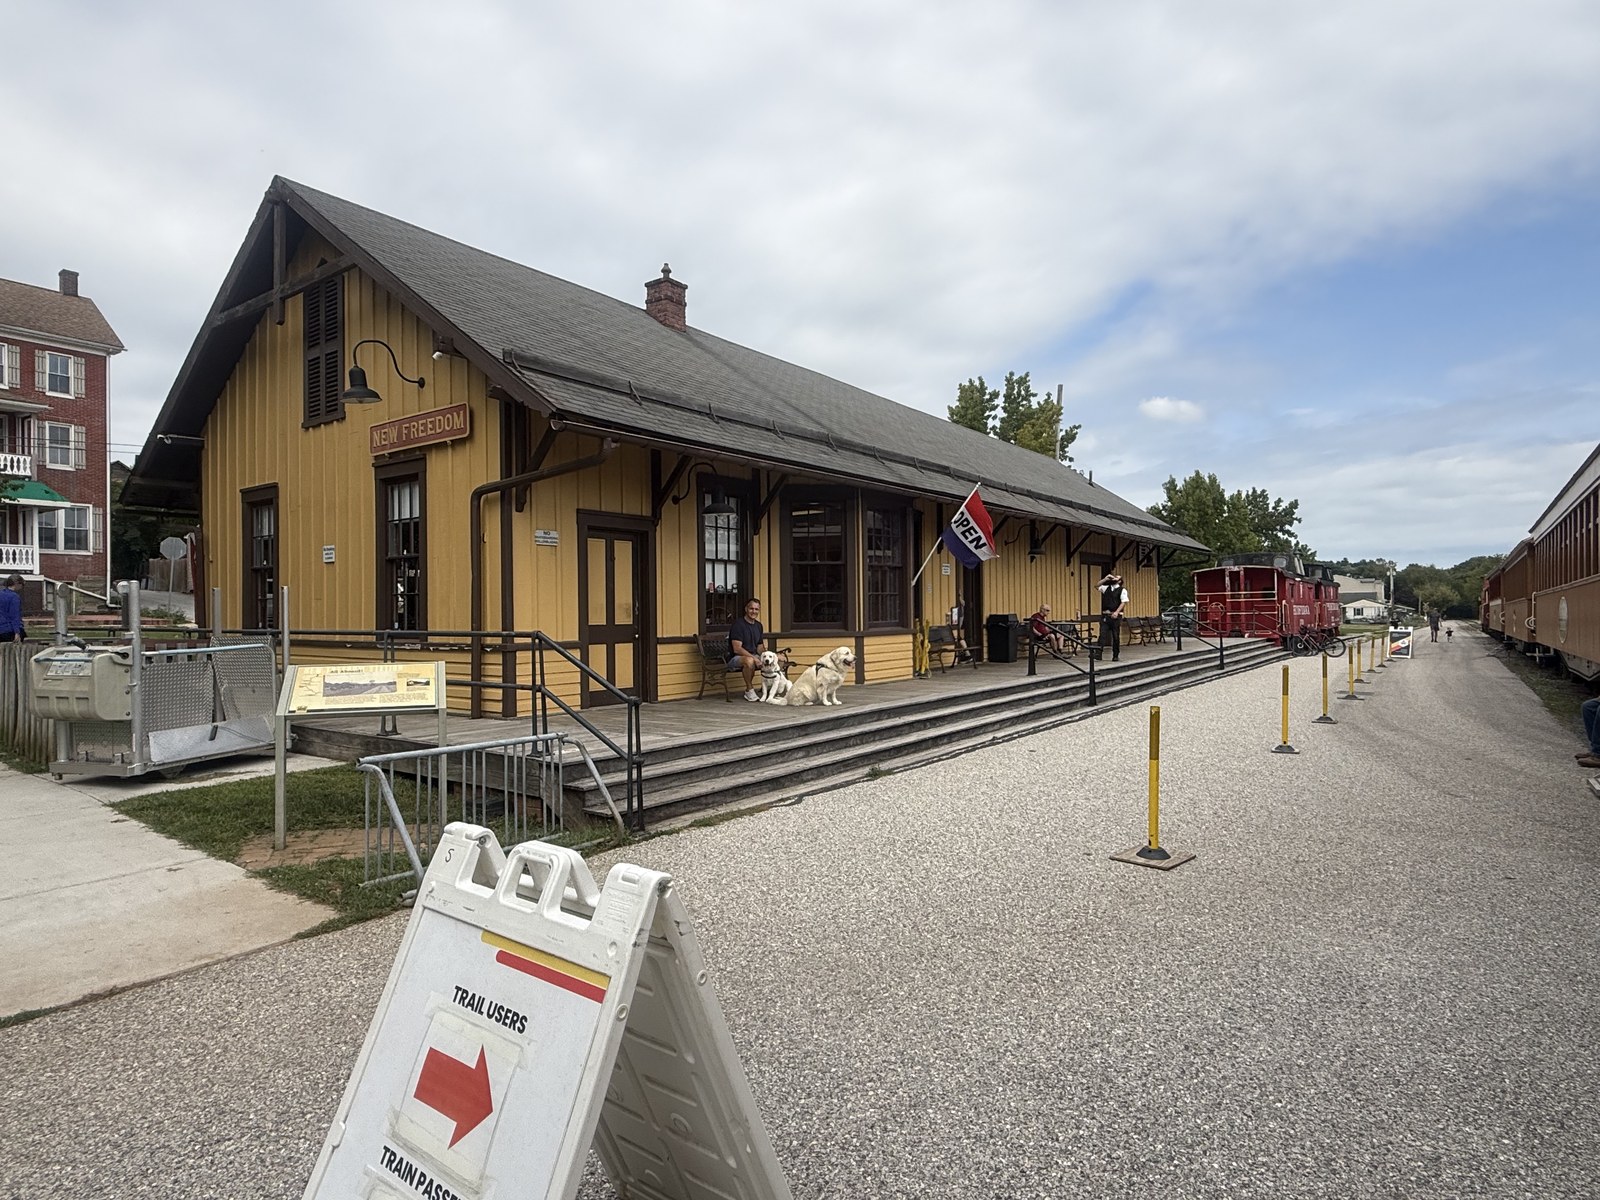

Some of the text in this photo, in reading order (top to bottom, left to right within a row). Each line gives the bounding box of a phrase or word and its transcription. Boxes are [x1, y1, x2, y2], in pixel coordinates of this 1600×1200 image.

[373, 410, 464, 449] NEW FREEDOM
[953, 511, 987, 550] OPEN
[452, 985, 528, 1034] TRAIL USERS
[380, 1145, 461, 1200] TRAIN PASS
